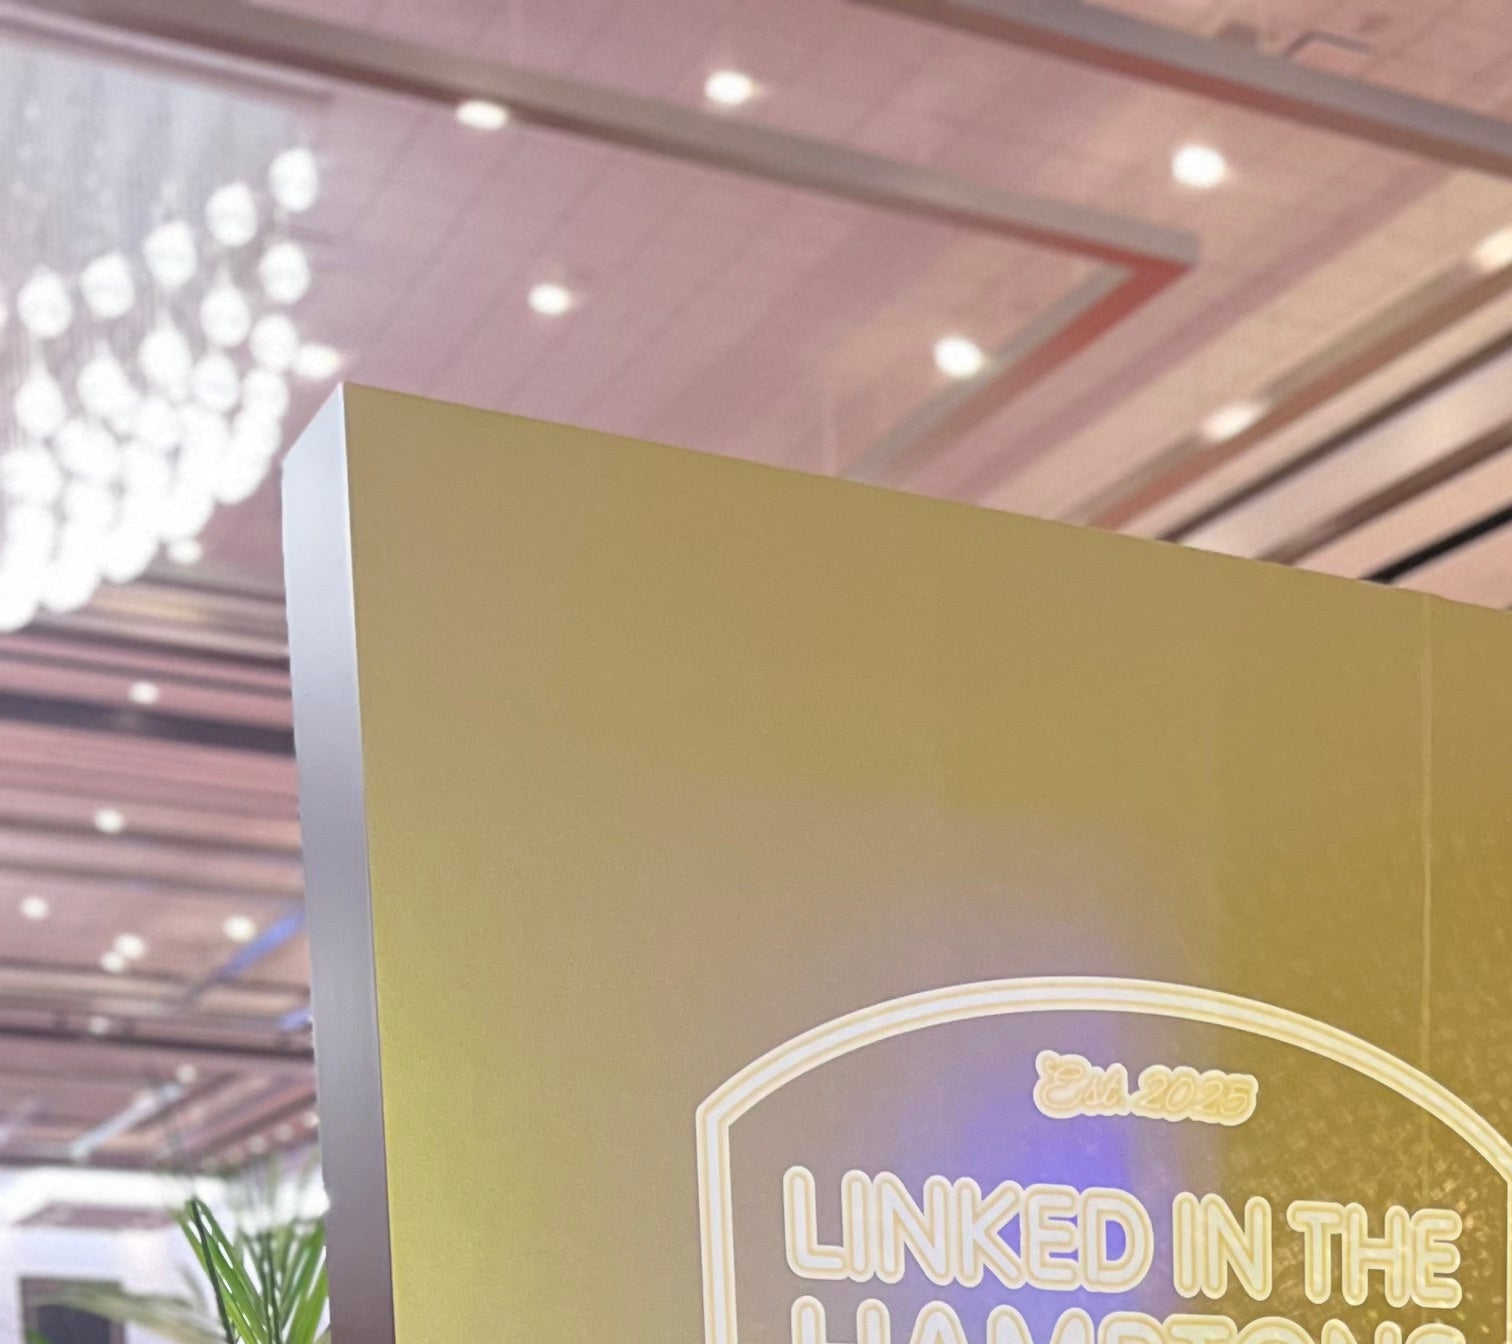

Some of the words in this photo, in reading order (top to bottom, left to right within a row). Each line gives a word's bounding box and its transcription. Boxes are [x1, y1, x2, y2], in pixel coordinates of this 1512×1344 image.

[1134, 1066, 1258, 1125] 2025
[783, 1166, 1154, 1293] LINKED
[1172, 1192, 1272, 1300] IN
[1287, 1201, 1462, 1309] THE
